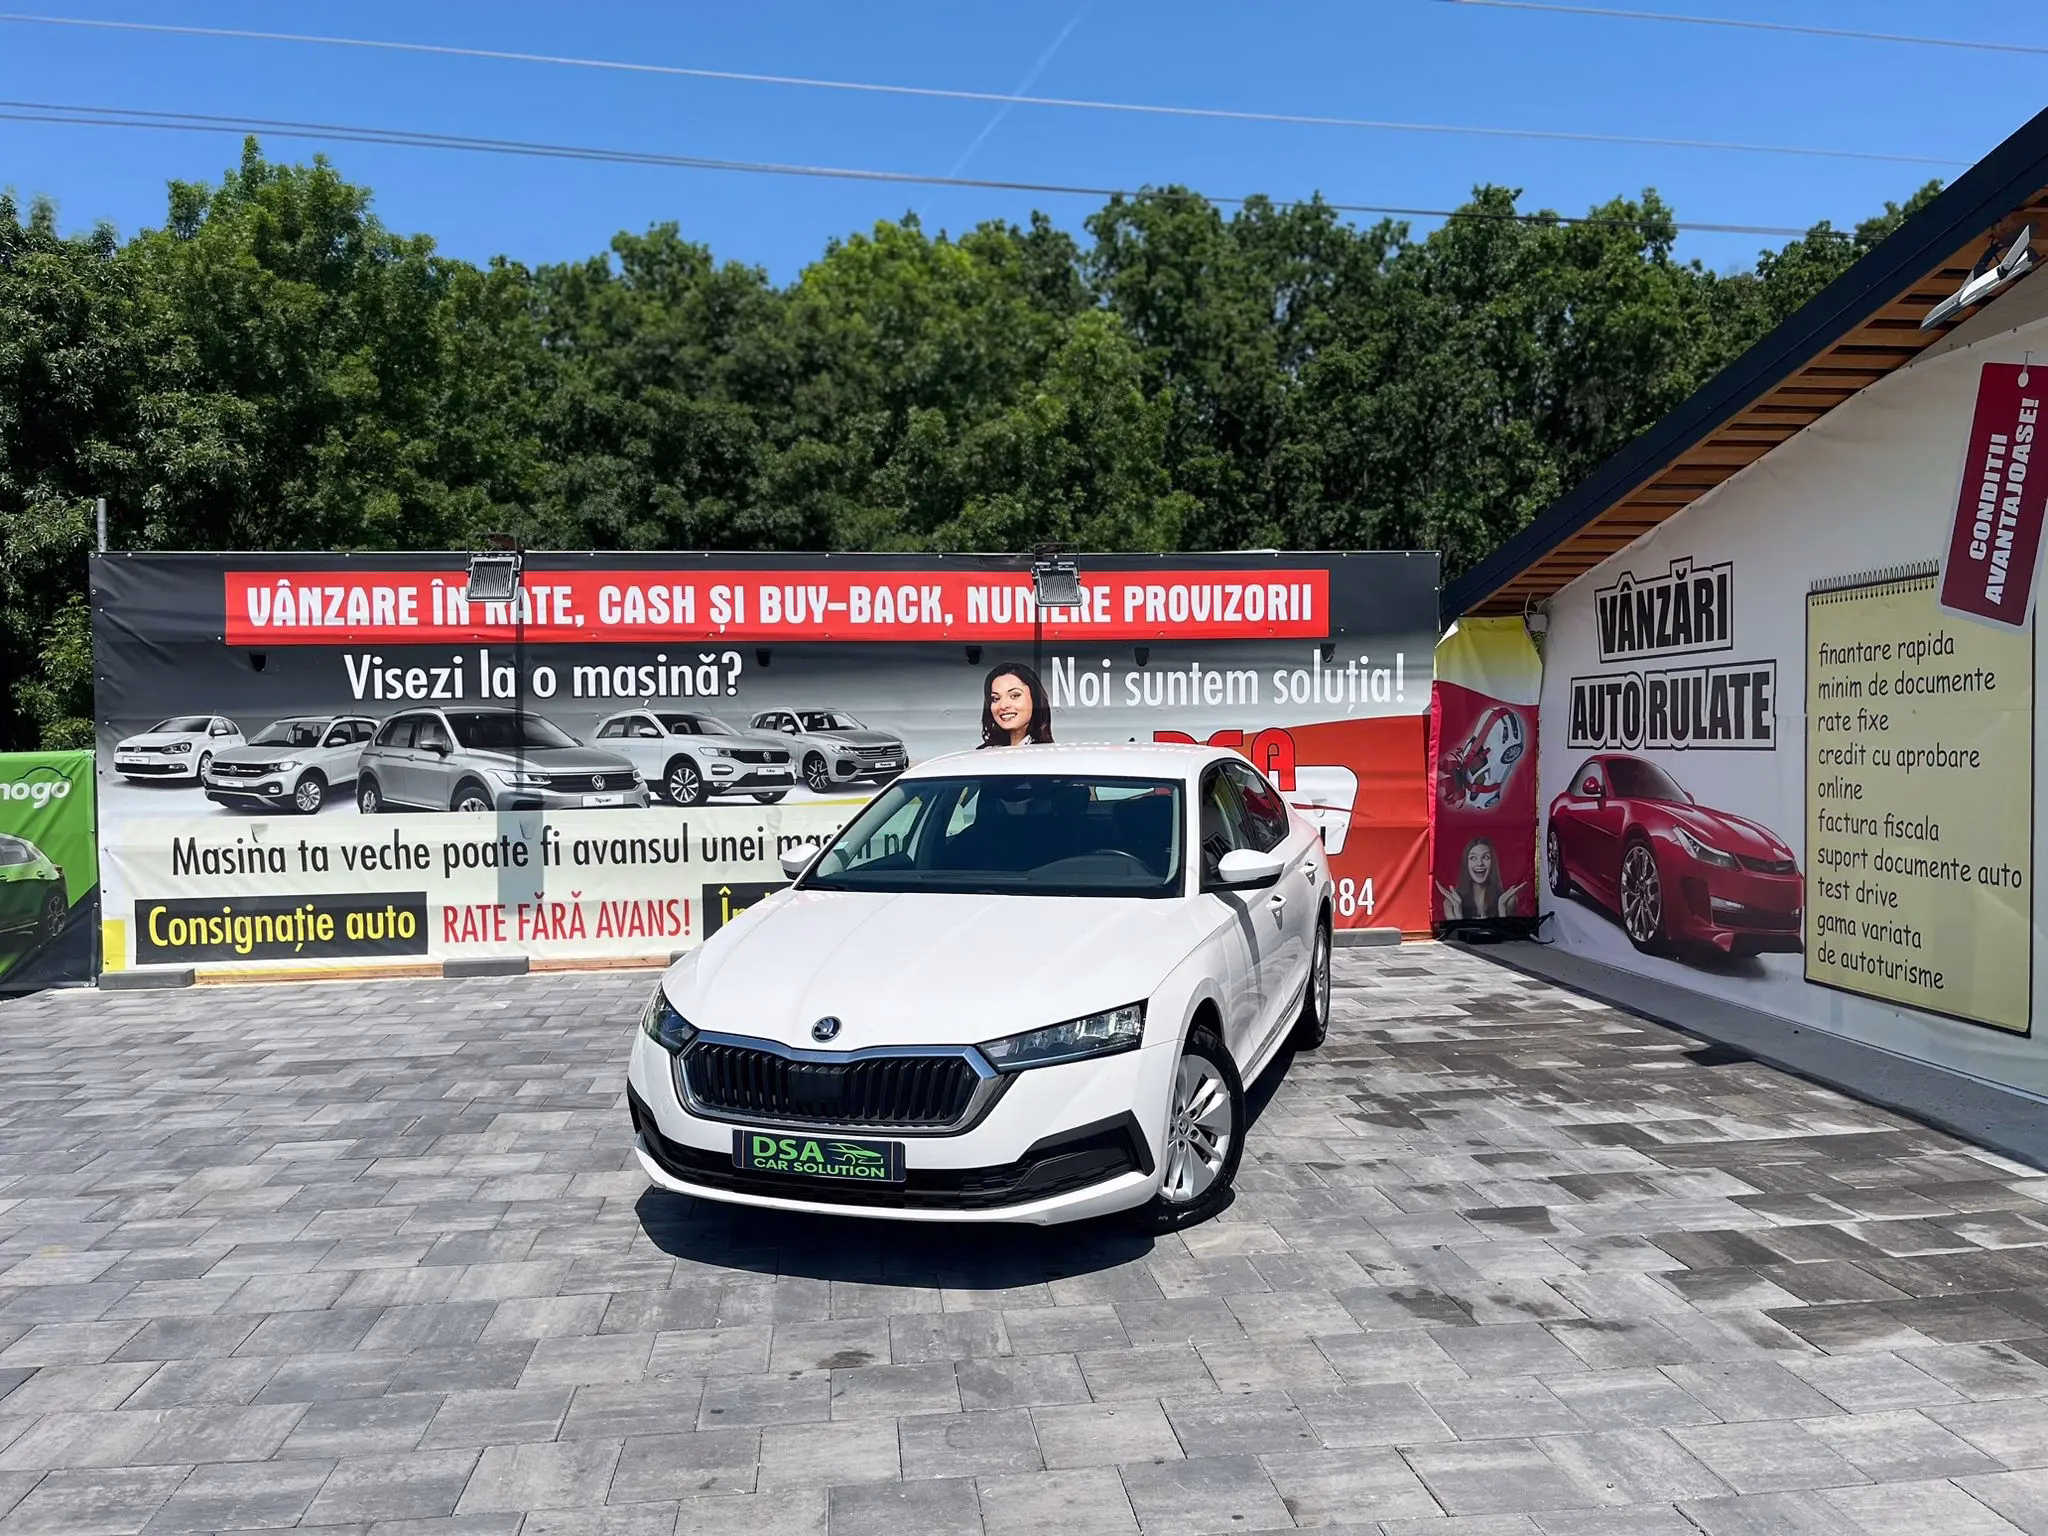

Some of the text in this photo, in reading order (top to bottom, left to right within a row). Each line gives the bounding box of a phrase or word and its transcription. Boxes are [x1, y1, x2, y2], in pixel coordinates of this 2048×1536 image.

[1969, 433, 2008, 561] CONDITII
[1984, 397, 2040, 606] AVANTAJOASE!
[247, 579, 419, 627] VÂNZARE
[430, 578, 470, 626] ÎN
[599, 585, 696, 625] CASH
[709, 585, 745, 633] ȘI
[759, 585, 953, 627] BUY-BACK,
[1124, 583, 1312, 623] PROVIZORII
[1599, 567, 1727, 654] VÂNZĂRI
[1818, 629, 1955, 667] finantare rapida
[343, 648, 742, 706] Visezi la o mașină?
[1051, 648, 1404, 713] Noi suntem soluția!
[1818, 667, 1996, 699] minim de documente
[1572, 671, 1771, 741] AUTO RULATE
[1817, 707, 1889, 732] rate fixe
[1818, 742, 1981, 775] credit cu aprobare
[1817, 775, 1863, 800] online
[1817, 808, 1940, 842] factura fiscala
[172, 837, 286, 875] Masina
[298, 839, 329, 872] ta
[340, 828, 431, 871] veche
[443, 835, 528, 878] poate
[540, 824, 561, 866] fi
[573, 822, 689, 866] avansul
[702, 826, 764, 862] unei
[1817, 847, 2022, 889] suport documente auto
[1817, 876, 1899, 908] test drive
[148, 903, 416, 954] Consignație auto
[443, 904, 506, 943] RATE
[518, 890, 587, 941] FĂRĂ
[596, 898, 690, 938] AVANS!
[1817, 914, 1922, 949] gama variata
[1817, 940, 1945, 990] de autoturisme
[752, 1135, 825, 1163] DSA
[753, 1158, 885, 1178] CAR SOLUTION
